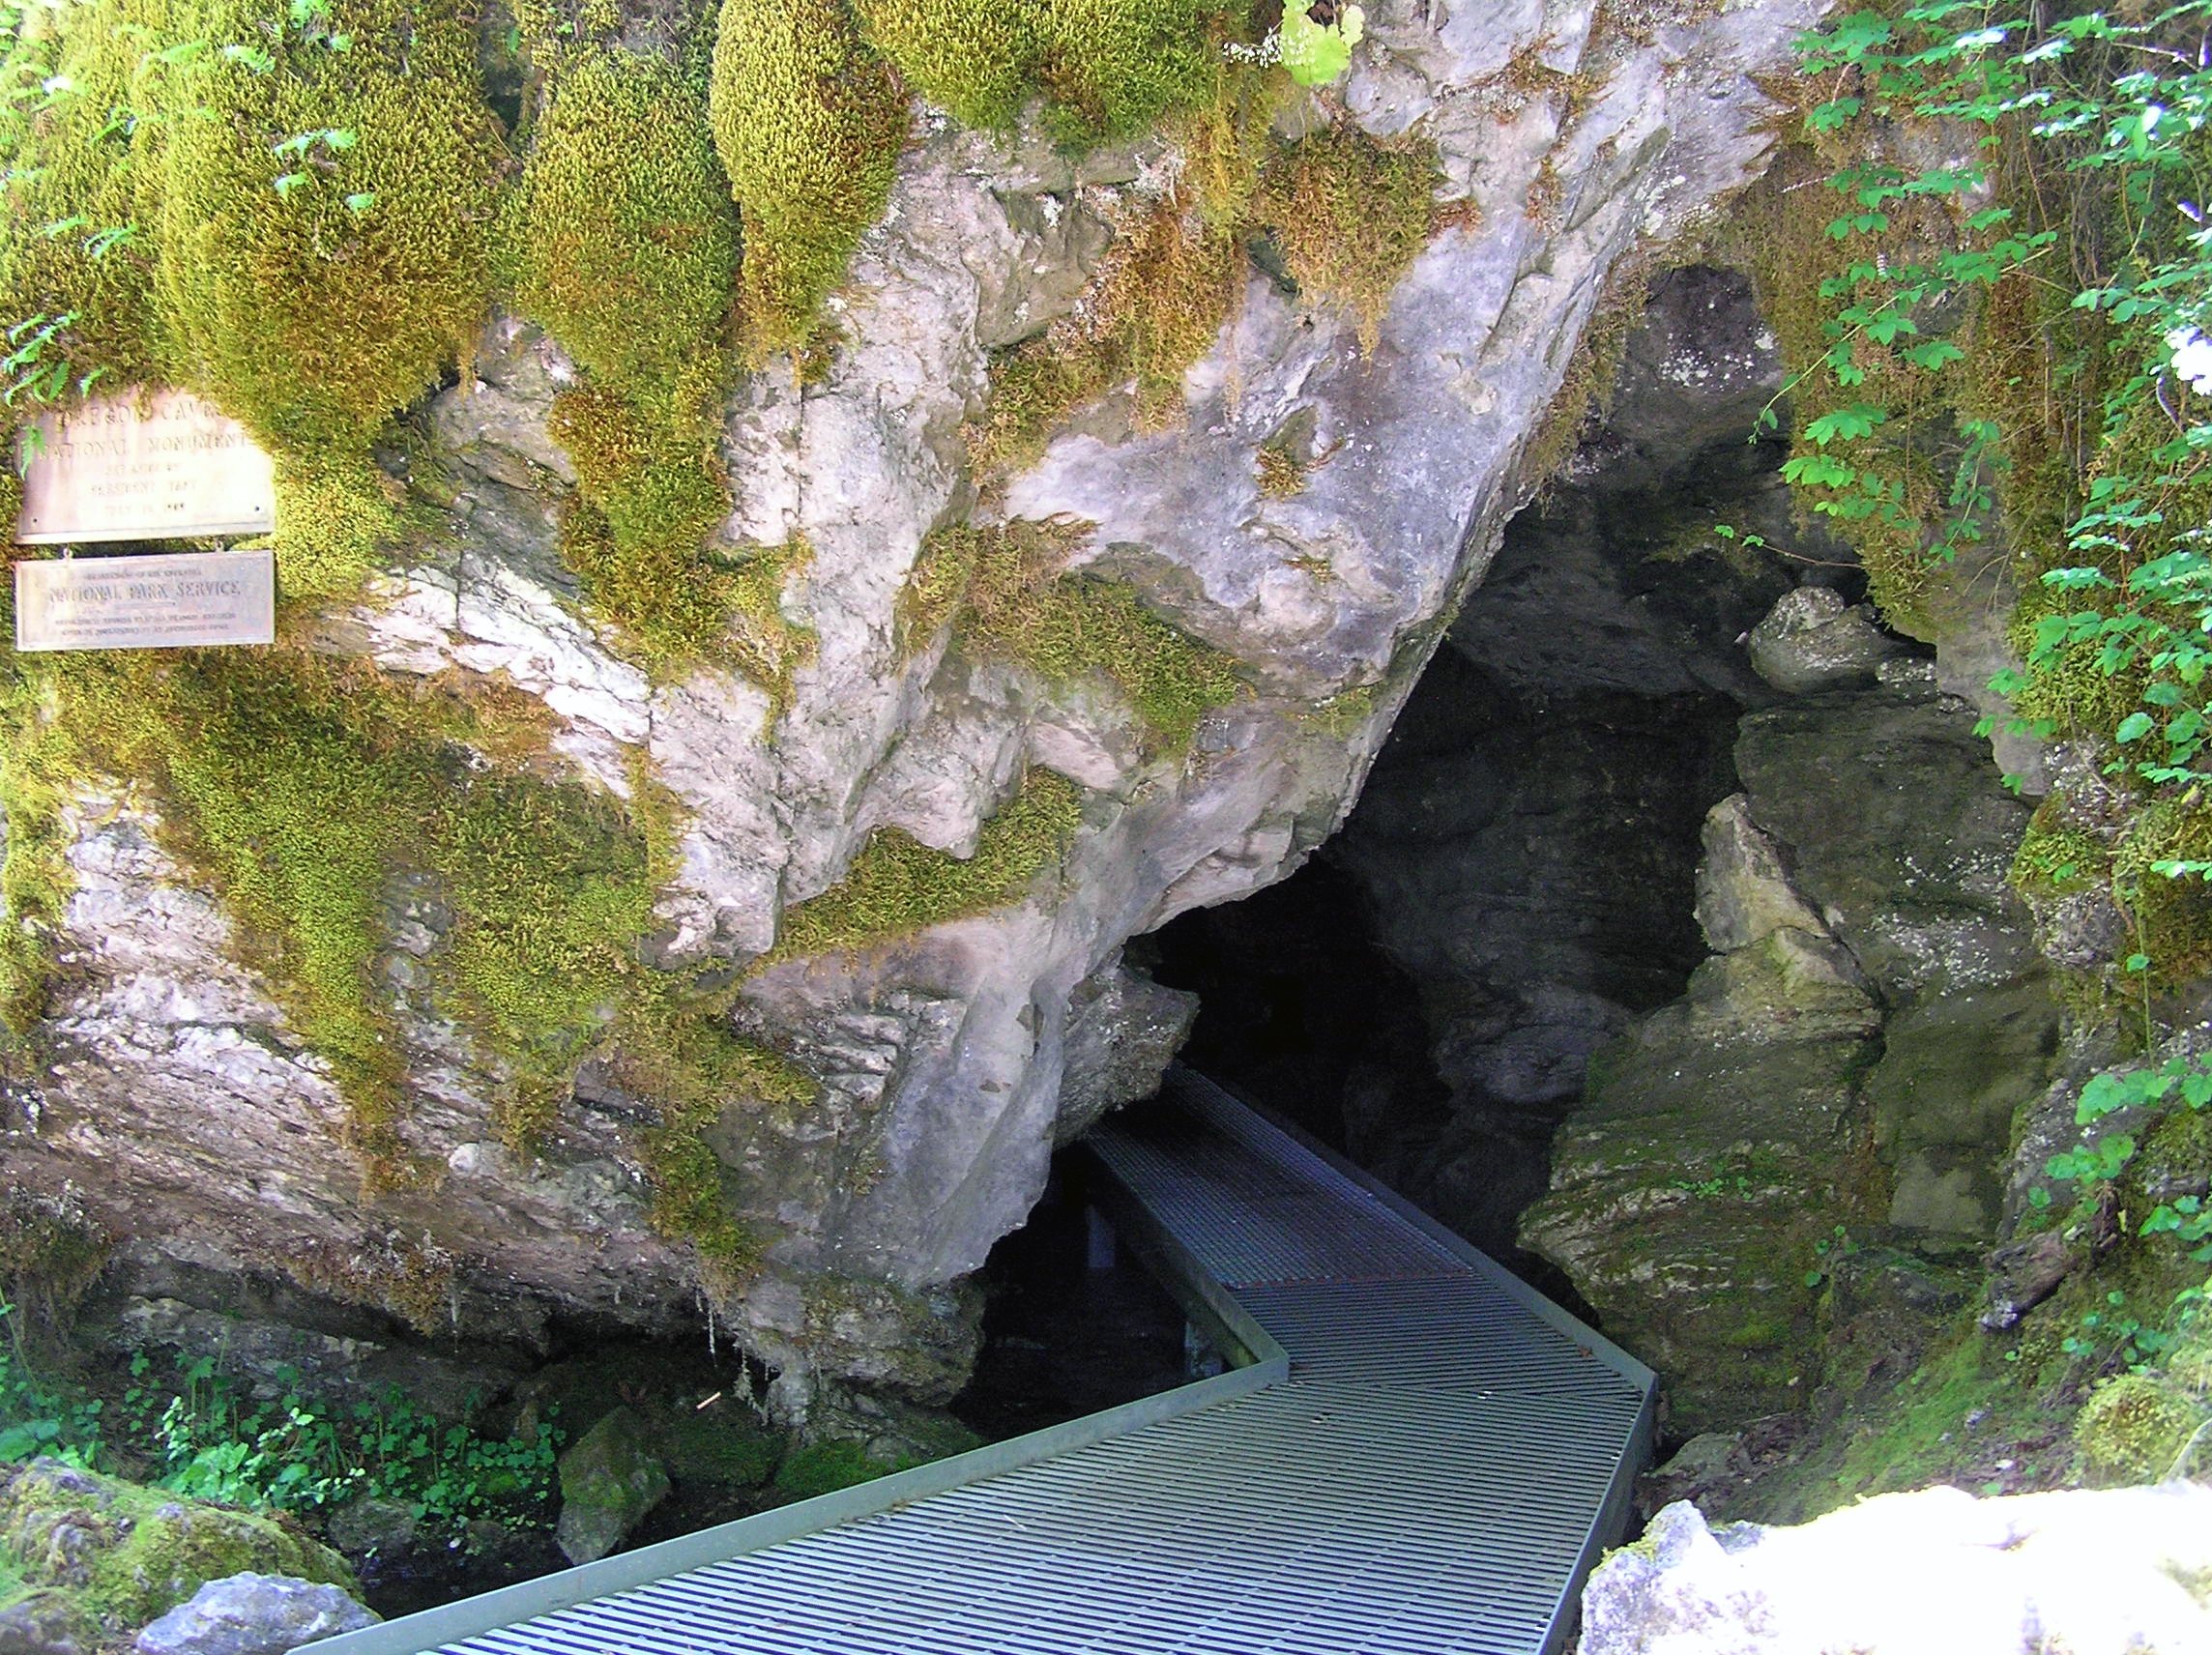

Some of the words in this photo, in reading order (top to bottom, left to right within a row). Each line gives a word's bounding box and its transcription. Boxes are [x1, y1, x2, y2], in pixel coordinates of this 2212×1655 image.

[58, 403, 146, 428] REGO
[161, 399, 218, 421] CAVE
[146, 432, 247, 453] MONUMENT
[49, 582, 123, 603] NATIONAL
[129, 581, 169, 599] PARK
[176, 579, 242, 597] SERVICE
